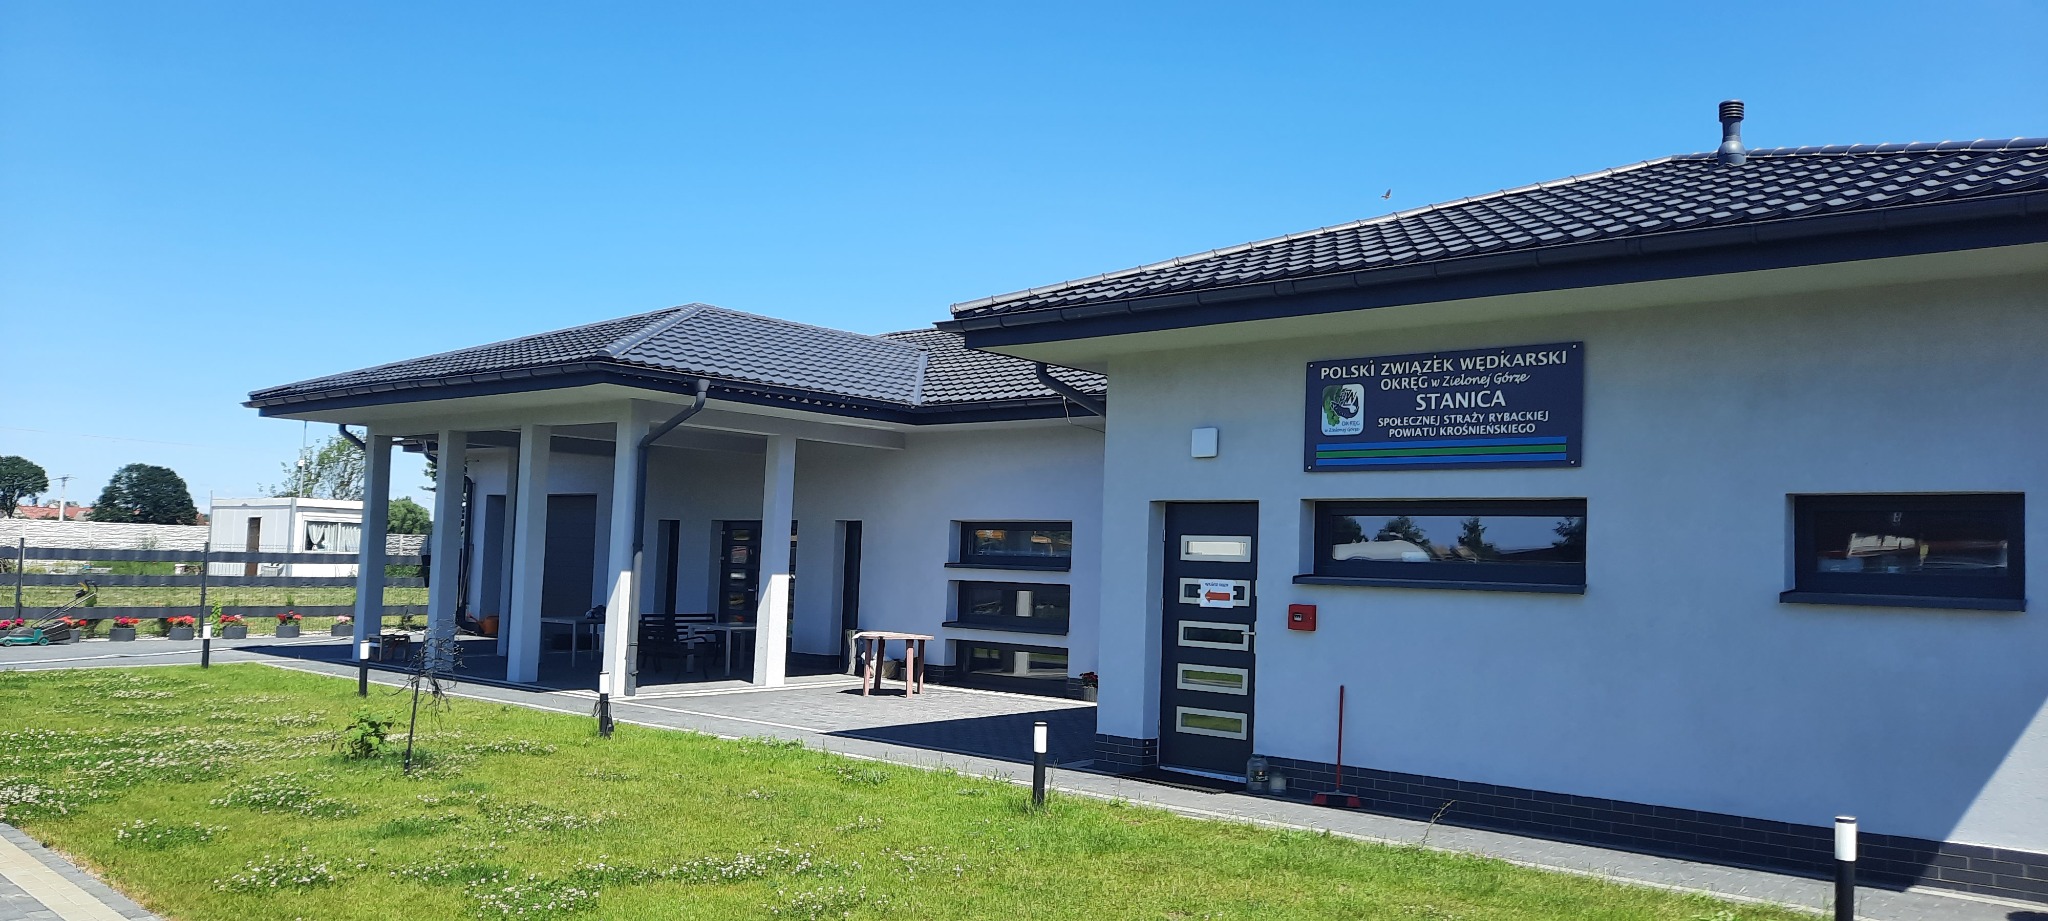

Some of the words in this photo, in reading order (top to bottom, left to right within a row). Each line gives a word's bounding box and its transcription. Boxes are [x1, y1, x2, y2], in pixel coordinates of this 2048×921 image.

[1321, 363, 1375, 380] POLSKI
[1381, 358, 1455, 376] ZWIĄZEK
[1460, 350, 1567, 371] WĘDKARSKI
[1380, 376, 1428, 391] OKRĘG
[1430, 378, 1440, 388] w
[1442, 373, 1492, 388] Zielonej
[1494, 371, 1531, 384] Górze
[1415, 389, 1506, 411] STANICA
[1378, 415, 1440, 427] SPOŁECZNEJ
[1443, 411, 1485, 424] STRAŻY
[1488, 410, 1549, 423] RYBACKIEJ
[1388, 427, 1436, 438] POWIATU
[1440, 422, 1536, 436] KROŚNIEŃSKIEGO
